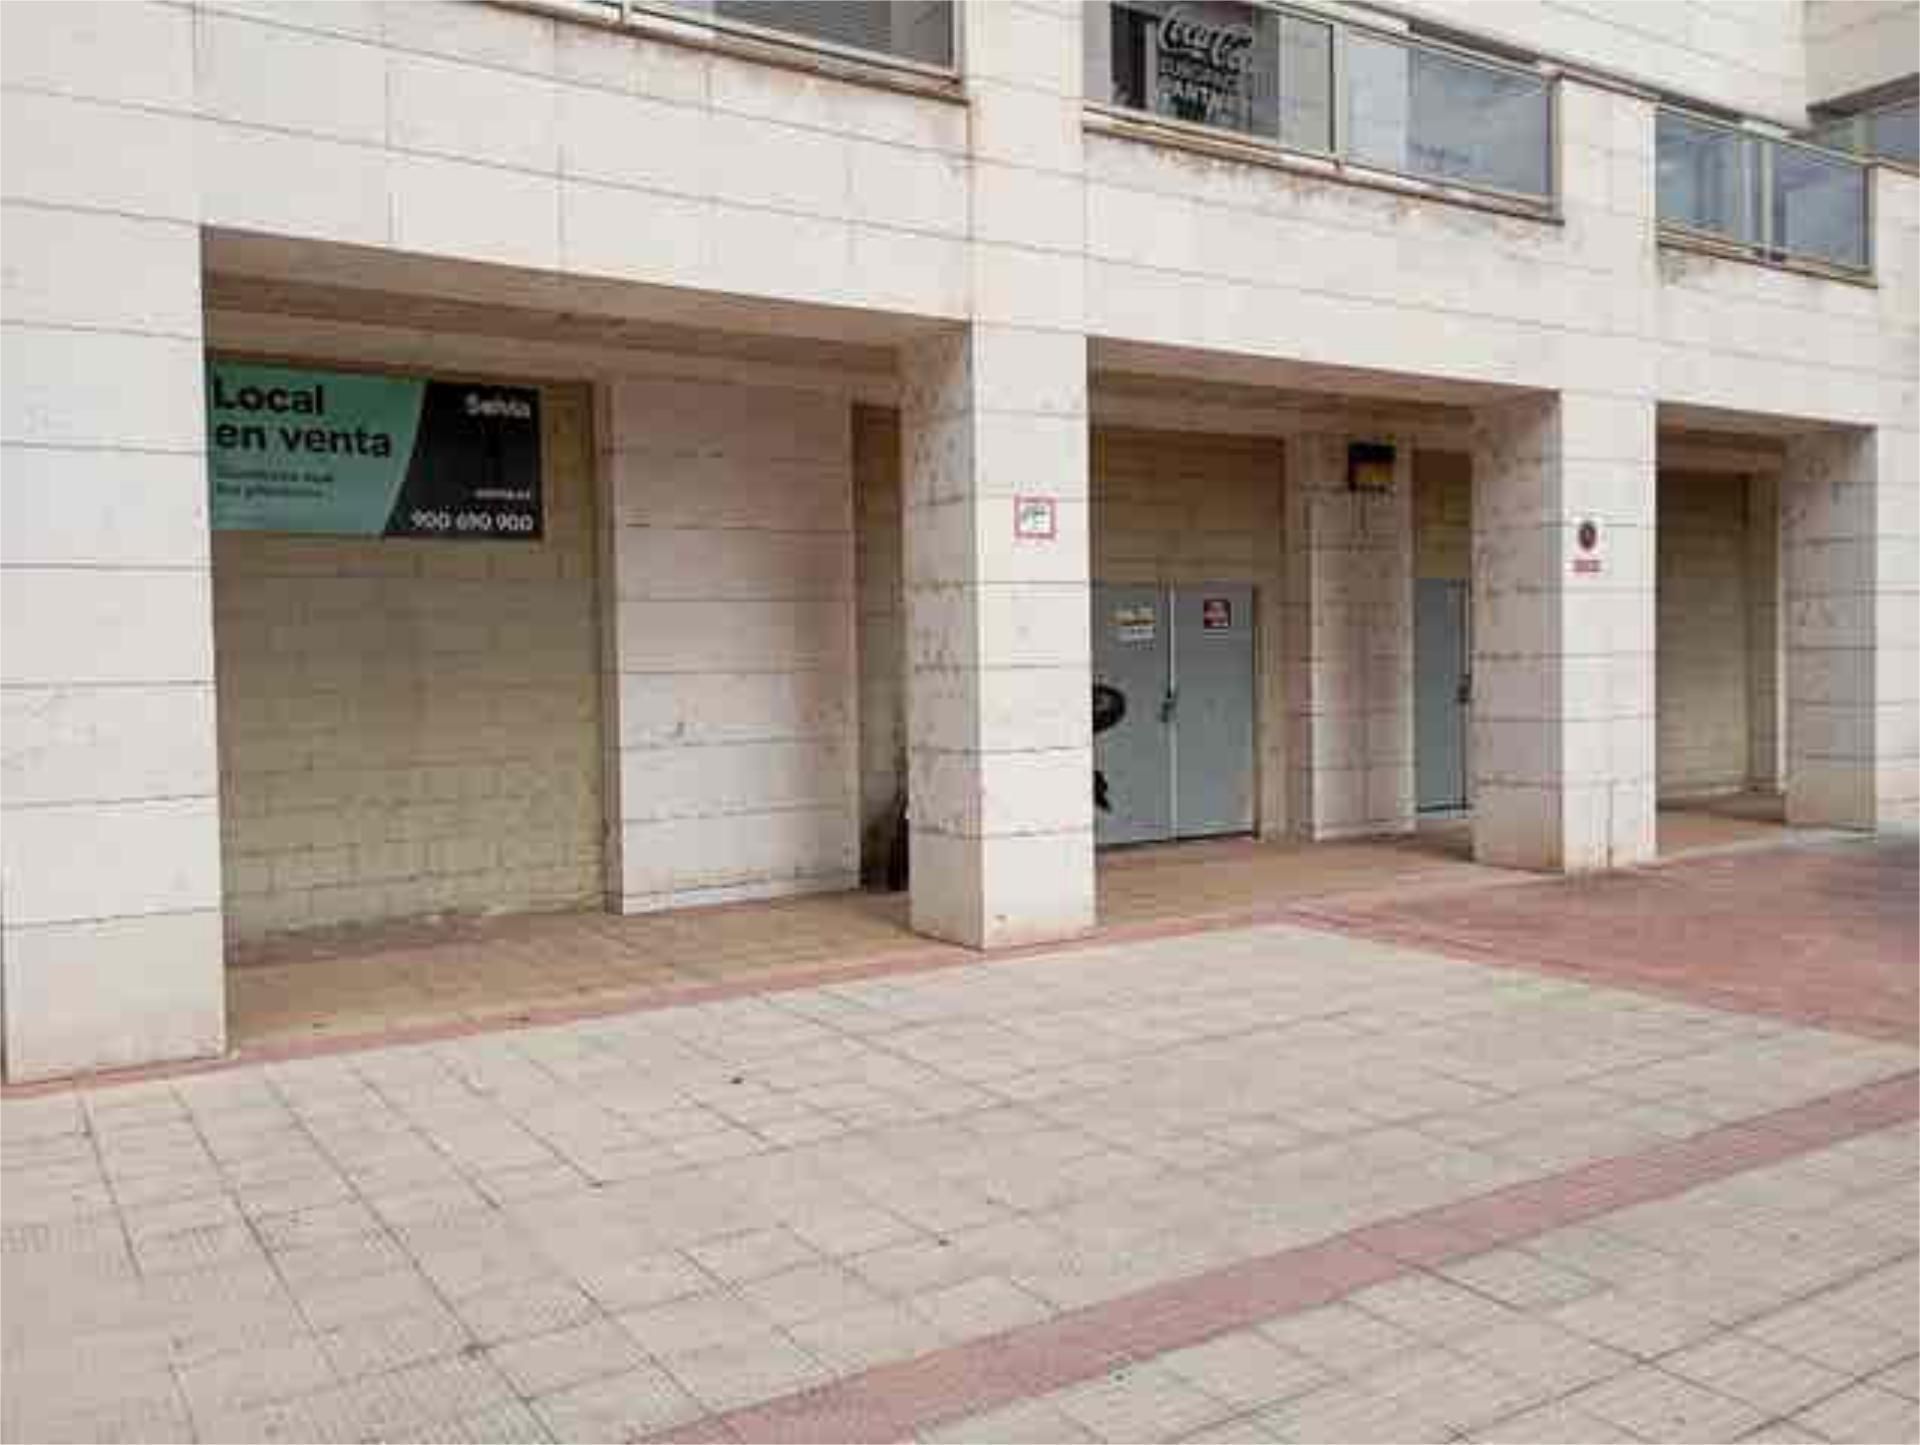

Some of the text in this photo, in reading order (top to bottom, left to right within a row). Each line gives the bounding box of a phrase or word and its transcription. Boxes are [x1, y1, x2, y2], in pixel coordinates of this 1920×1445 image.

[213, 375, 324, 416] Local
[216, 423, 391, 458] en venta
[411, 509, 450, 529] 900
[496, 513, 534, 532] 900
